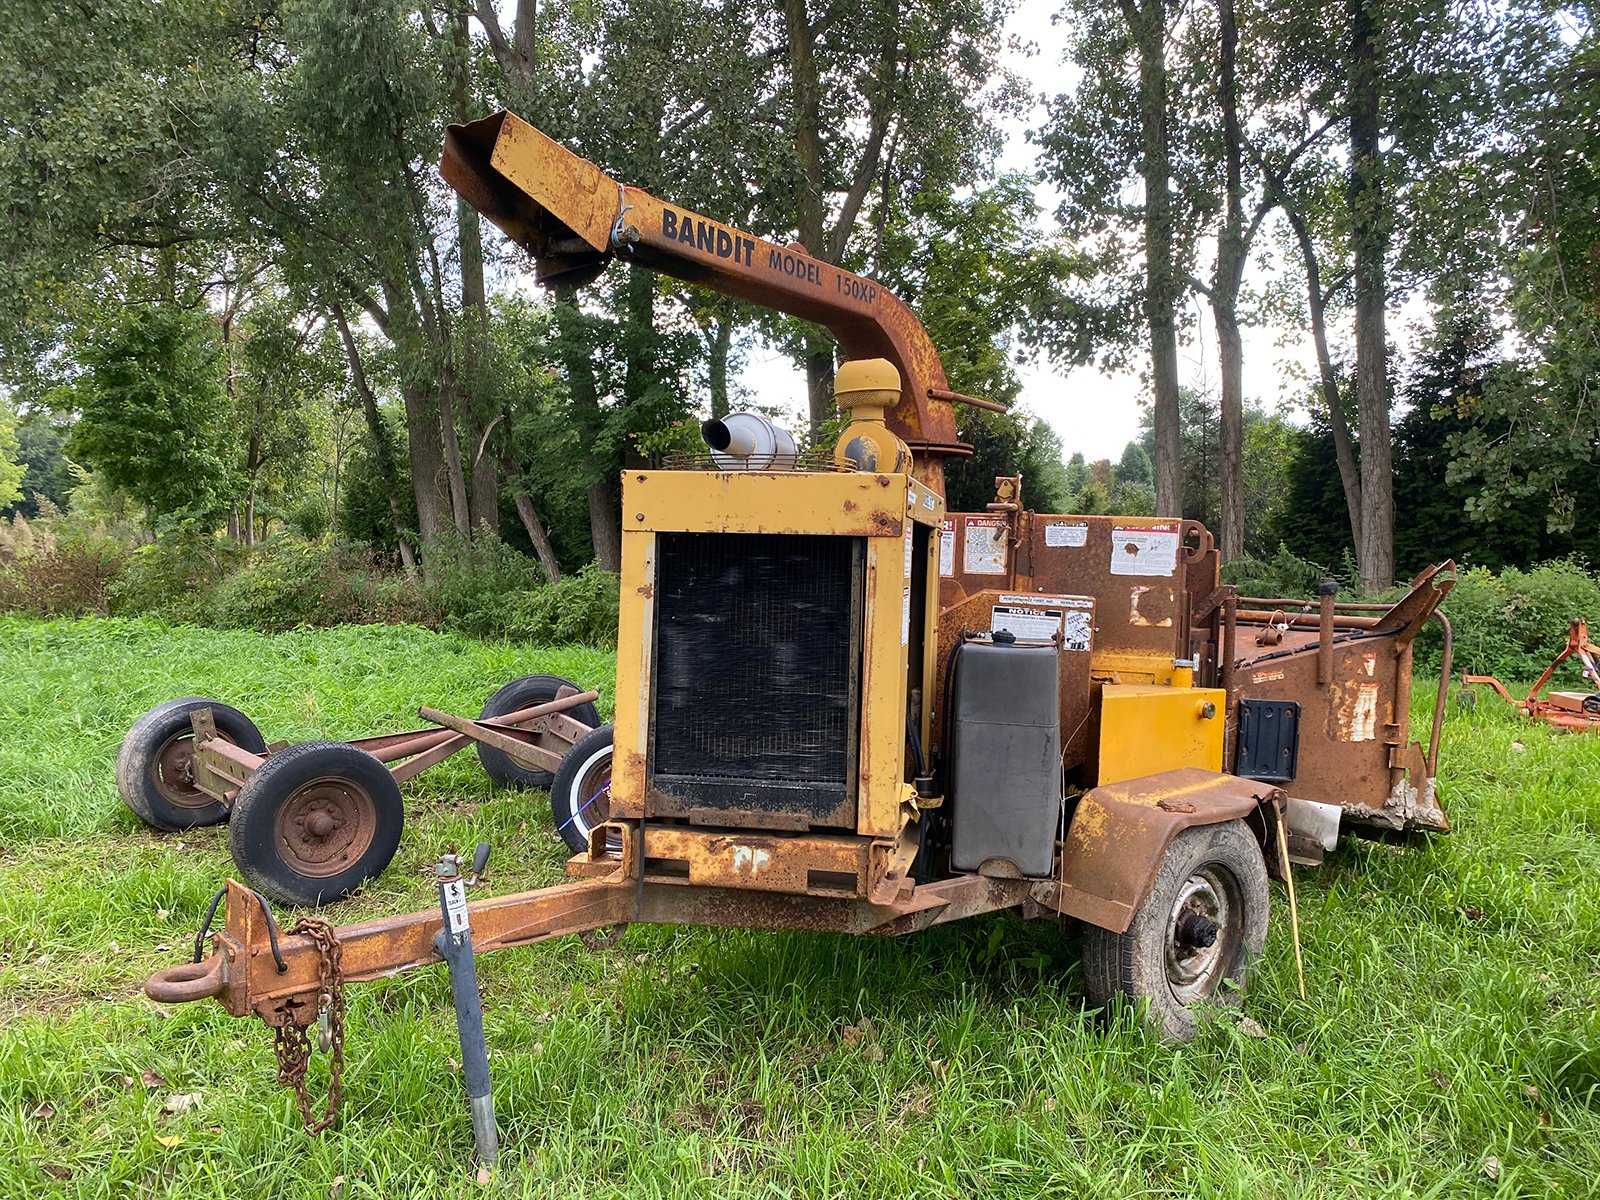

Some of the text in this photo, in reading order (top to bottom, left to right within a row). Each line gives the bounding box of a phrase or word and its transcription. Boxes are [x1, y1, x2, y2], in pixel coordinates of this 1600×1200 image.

[662, 208, 877, 304] BANDIT MODEL 150XP
[1008, 608, 1047, 616] NOTICE
